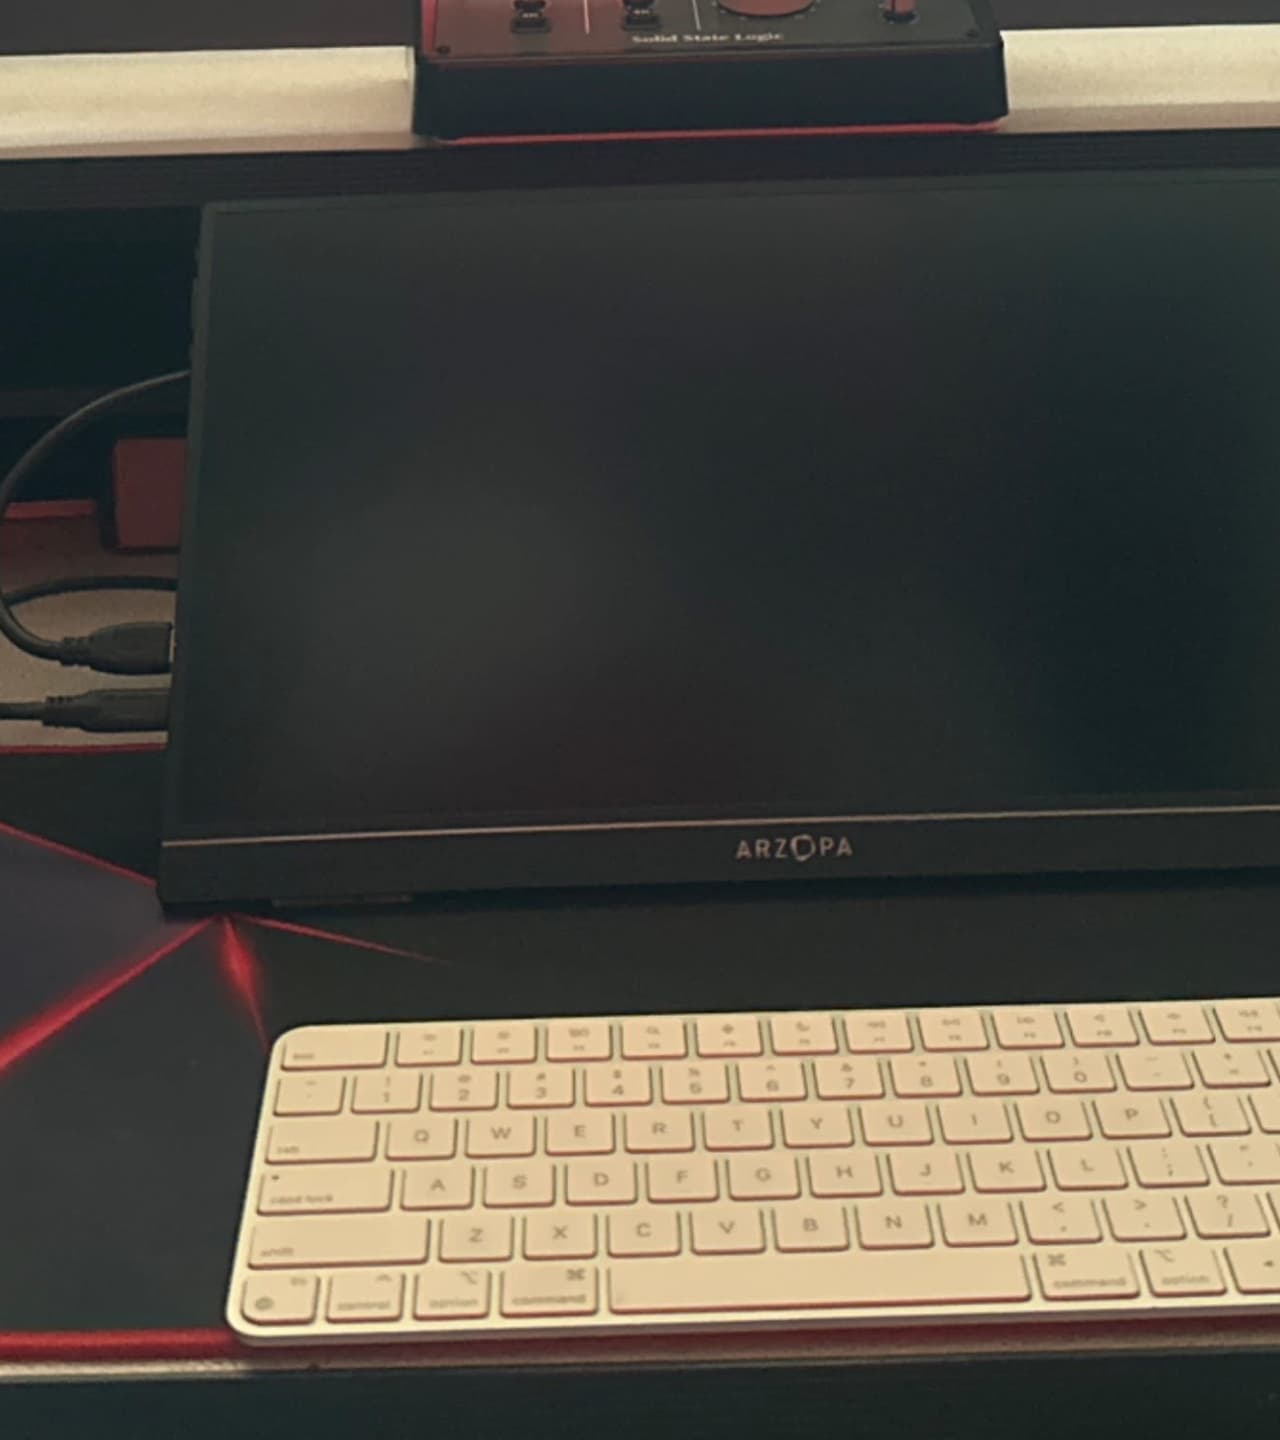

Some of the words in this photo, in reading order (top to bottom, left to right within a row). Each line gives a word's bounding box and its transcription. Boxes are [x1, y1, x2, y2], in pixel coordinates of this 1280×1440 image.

[631, 33, 679, 44] Solid
[683, 32, 730, 43] State
[734, 31, 784, 44] Logic
[735, 833, 854, 862] ARZOPA
